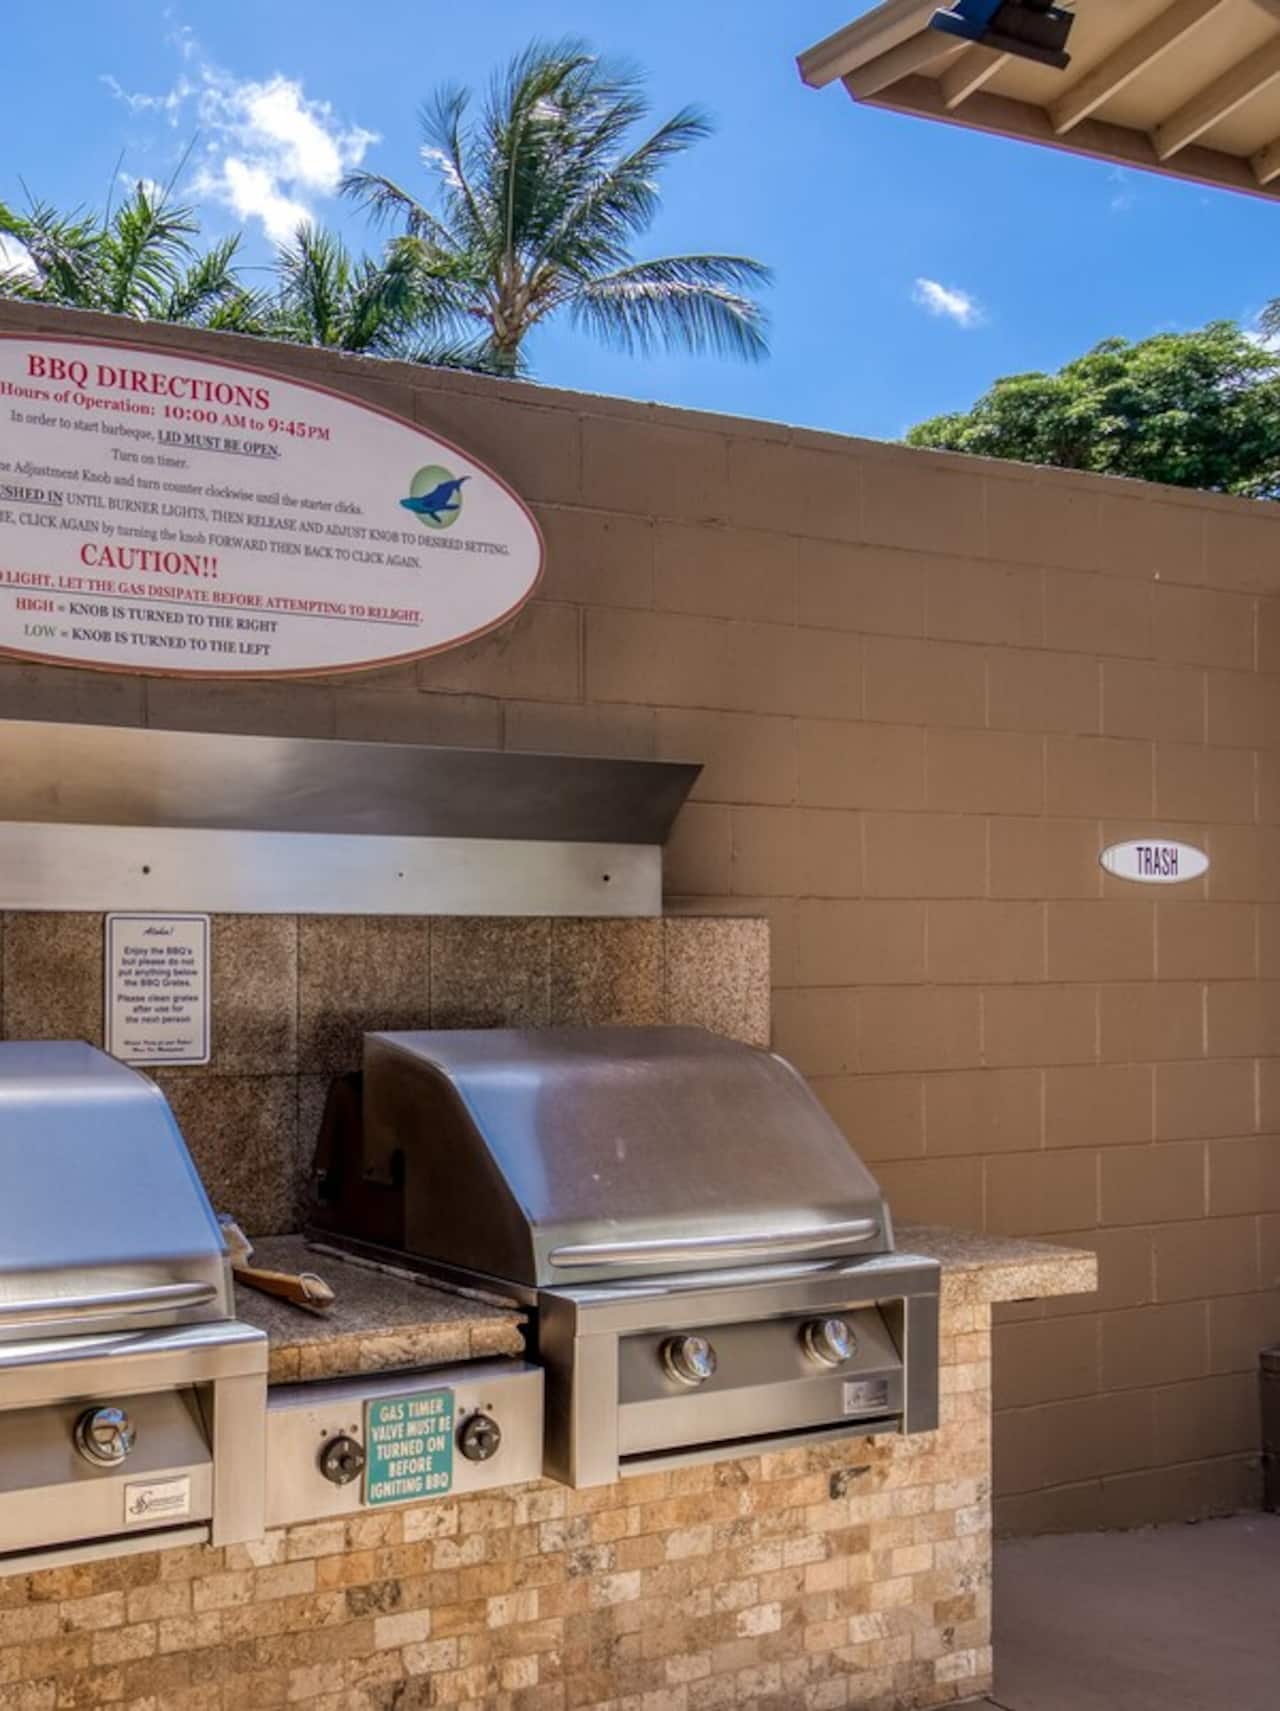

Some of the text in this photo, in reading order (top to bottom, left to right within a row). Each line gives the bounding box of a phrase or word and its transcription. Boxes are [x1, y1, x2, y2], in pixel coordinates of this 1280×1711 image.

[27, 354, 270, 410] BBQ DIRECTIONS
[0, 381, 50, 401] Hours
[53, 391, 71, 402] of
[73, 392, 155, 416] Operation:
[164, 404, 218, 424] 10:00
[222, 416, 246, 429] AM
[249, 418, 264, 431] to
[10, 409, 23, 422] In
[26, 413, 57, 428] order
[59, 417, 71, 428] to
[74, 419, 99, 433] start
[158, 430, 181, 443] LID
[184, 433, 221, 449] MUST
[223, 438, 240, 450] BE
[112, 449, 190, 469] Turn on timer.
[14, 460, 79, 480] Adjustment
[81, 469, 112, 484] Knob
[114, 475, 135, 488] and
[137, 477, 161, 490] turn
[162, 482, 203, 496] counter
[205, 484, 254, 501] clockwise
[255, 492, 280, 505] until
[282, 493, 298, 507] the
[300, 497, 333, 512] starter
[47, 490, 64, 503] IN
[66, 492, 106, 509] UNTIL
[108, 497, 160, 515] BURNER
[161, 503, 209, 522] LIGHTS,
[212, 509, 245, 524] THEN
[247, 514, 297, 531] RELEASE
[299, 521, 324, 534] AND
[325, 524, 369, 540] ADJUST
[370, 529, 400, 543] KNOB
[402, 533, 417, 545] TO
[418, 534, 464, 551] DESIRED
[19, 512, 58, 529] CLICK
[59, 517, 100, 533] AGAIN
[102, 520, 115, 537] by
[117, 524, 158, 542] turning
[159, 528, 177, 541] the
[179, 529, 206, 544] knob
[208, 533, 267, 552] FORWARD
[271, 541, 301, 555] THEN
[304, 544, 333, 559] BACK
[335, 548, 350, 561] TO
[352, 550, 384, 565] CLICK
[80, 543, 218, 579] CAUTION!!
[58, 576, 84, 590] LET
[85, 578, 114, 593] THE
[118, 582, 145, 596] GAS
[148, 585, 209, 602] DISIPATE
[212, 591, 263, 607] BEFORE
[266, 597, 347, 615] ATTEMPTING
[349, 605, 366, 617] TO
[16, 597, 54, 612] HIGH
[69, 602, 110, 617] KNOB
[112, 606, 125, 619] IS
[129, 607, 185, 625] TURNED
[187, 613, 205, 627] TO
[208, 615, 233, 629] THE
[236, 617, 278, 633] RIGHT
[24, 623, 58, 638] LOW
[71, 627, 112, 642] KNOB
[115, 631, 129, 644] IS
[131, 633, 187, 650] TURNED
[190, 638, 207, 652] TO
[210, 639, 236, 654] THE
[239, 642, 272, 656] LEFT
[1136, 847, 1178, 876] TRASH
[124, 946, 148, 956] Enjoy
[151, 947, 164, 955] the
[138, 958, 166, 967] please
[118, 968, 198, 978] put anything below
[140, 979, 161, 987] BBQ
[133, 1005, 152, 1013] after
[172, 1005, 185, 1013] for
[379, 1399, 444, 1422] GAS TIMER
[371, 1416, 452, 1442] VALVE MUST BE
[376, 1436, 446, 1461] TURNED ON
[388, 1456, 433, 1478] BEFORE
[370, 1472, 449, 1498] IGNITING BBQ
